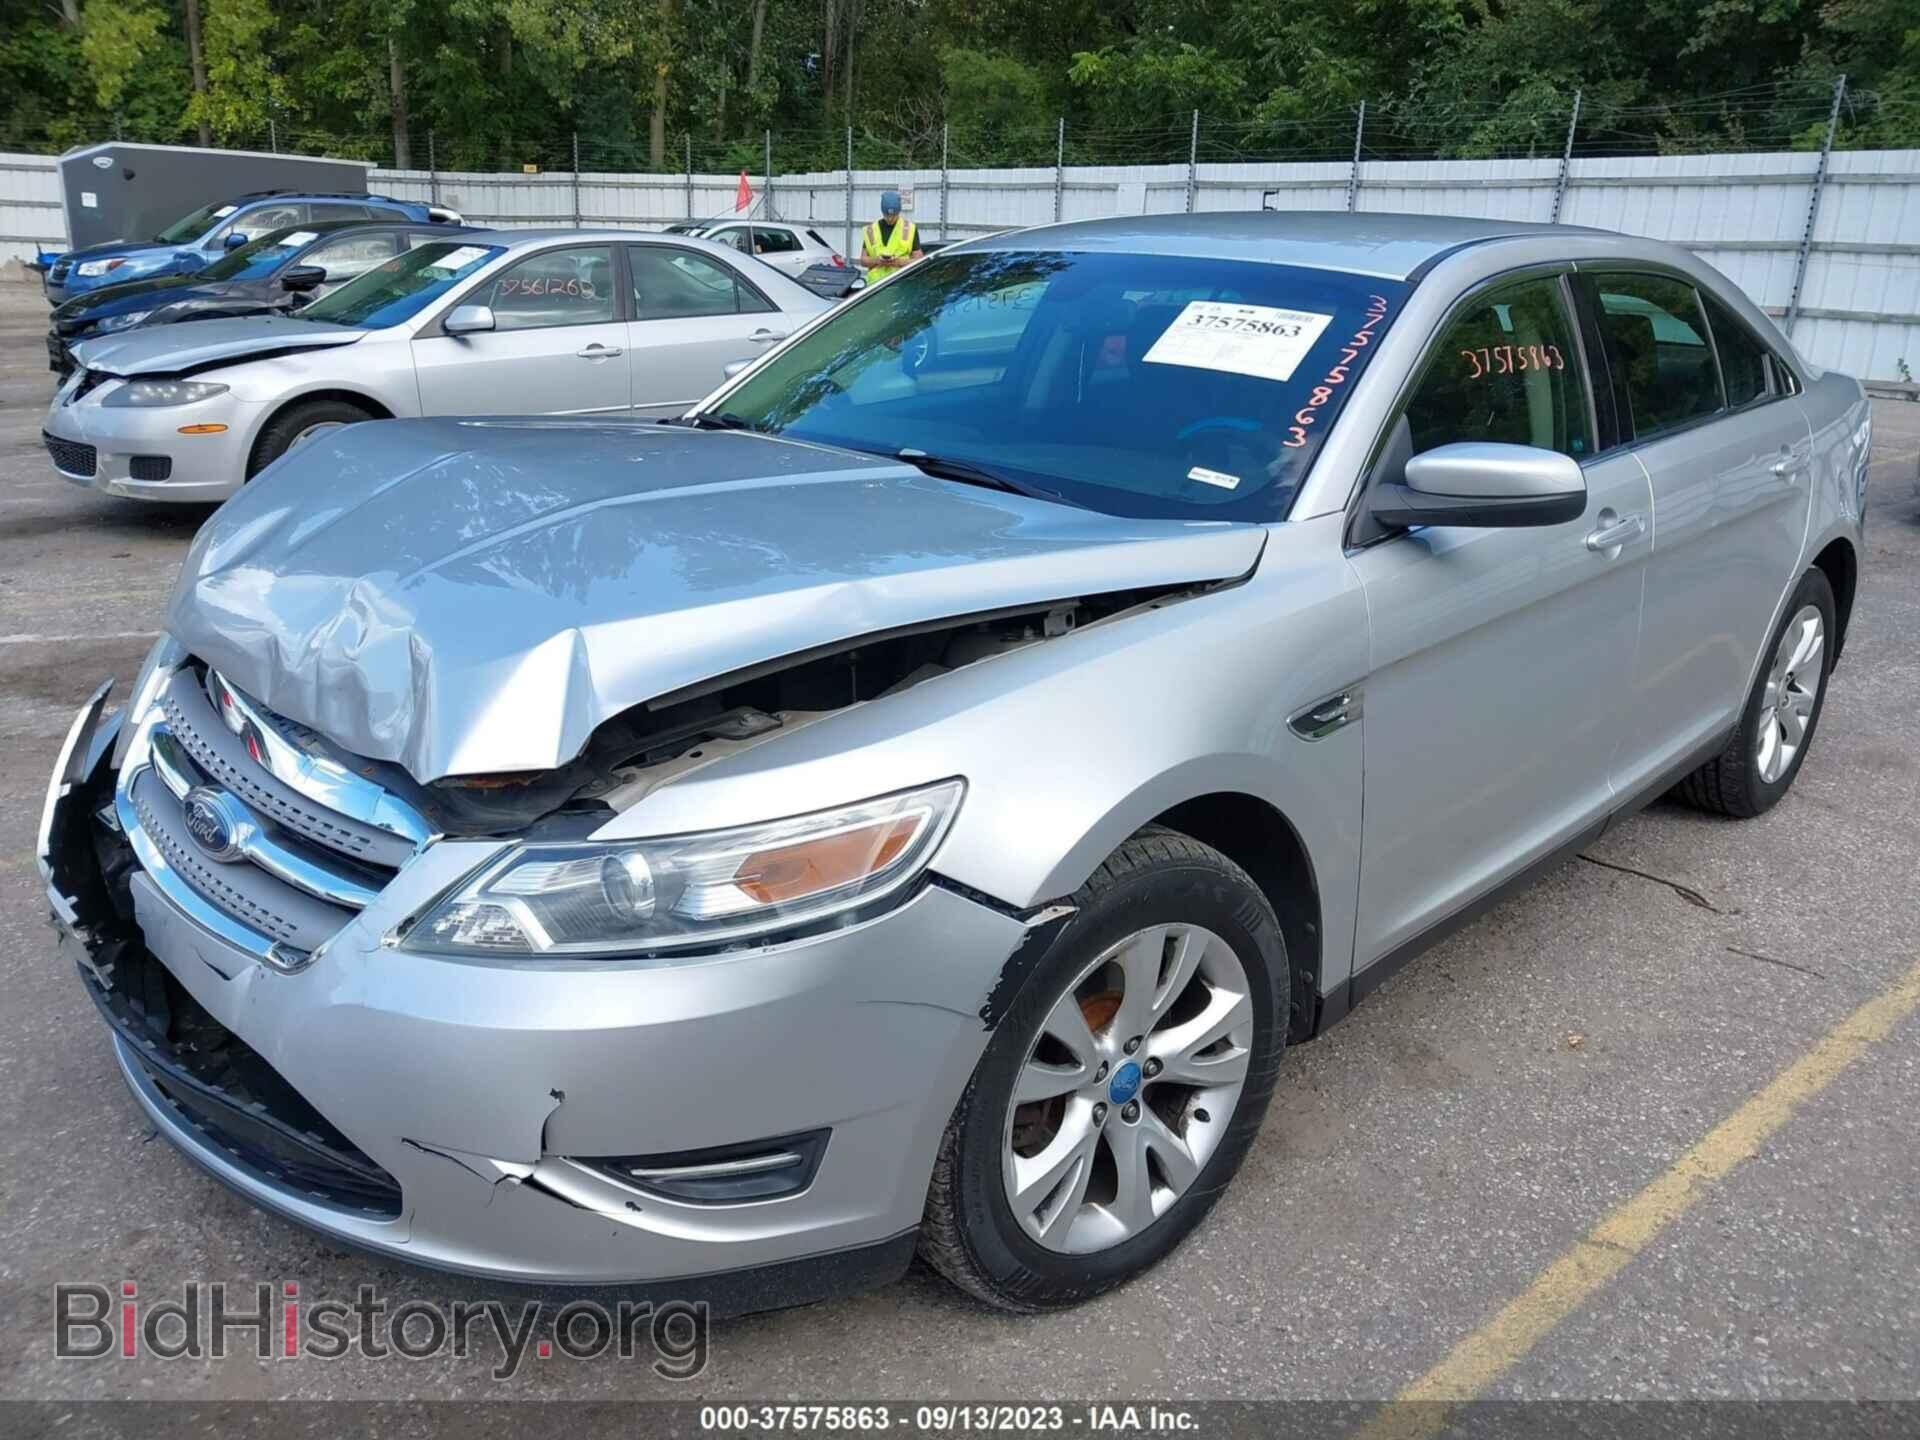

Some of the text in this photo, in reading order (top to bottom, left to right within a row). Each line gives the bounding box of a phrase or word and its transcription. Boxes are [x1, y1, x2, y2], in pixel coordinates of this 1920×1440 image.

[1186, 314, 1302, 338] 37575863
[1282, 294, 1388, 448] 37575863
[1461, 344, 1565, 379] 37575863
[187, 802, 218, 843] Ford
